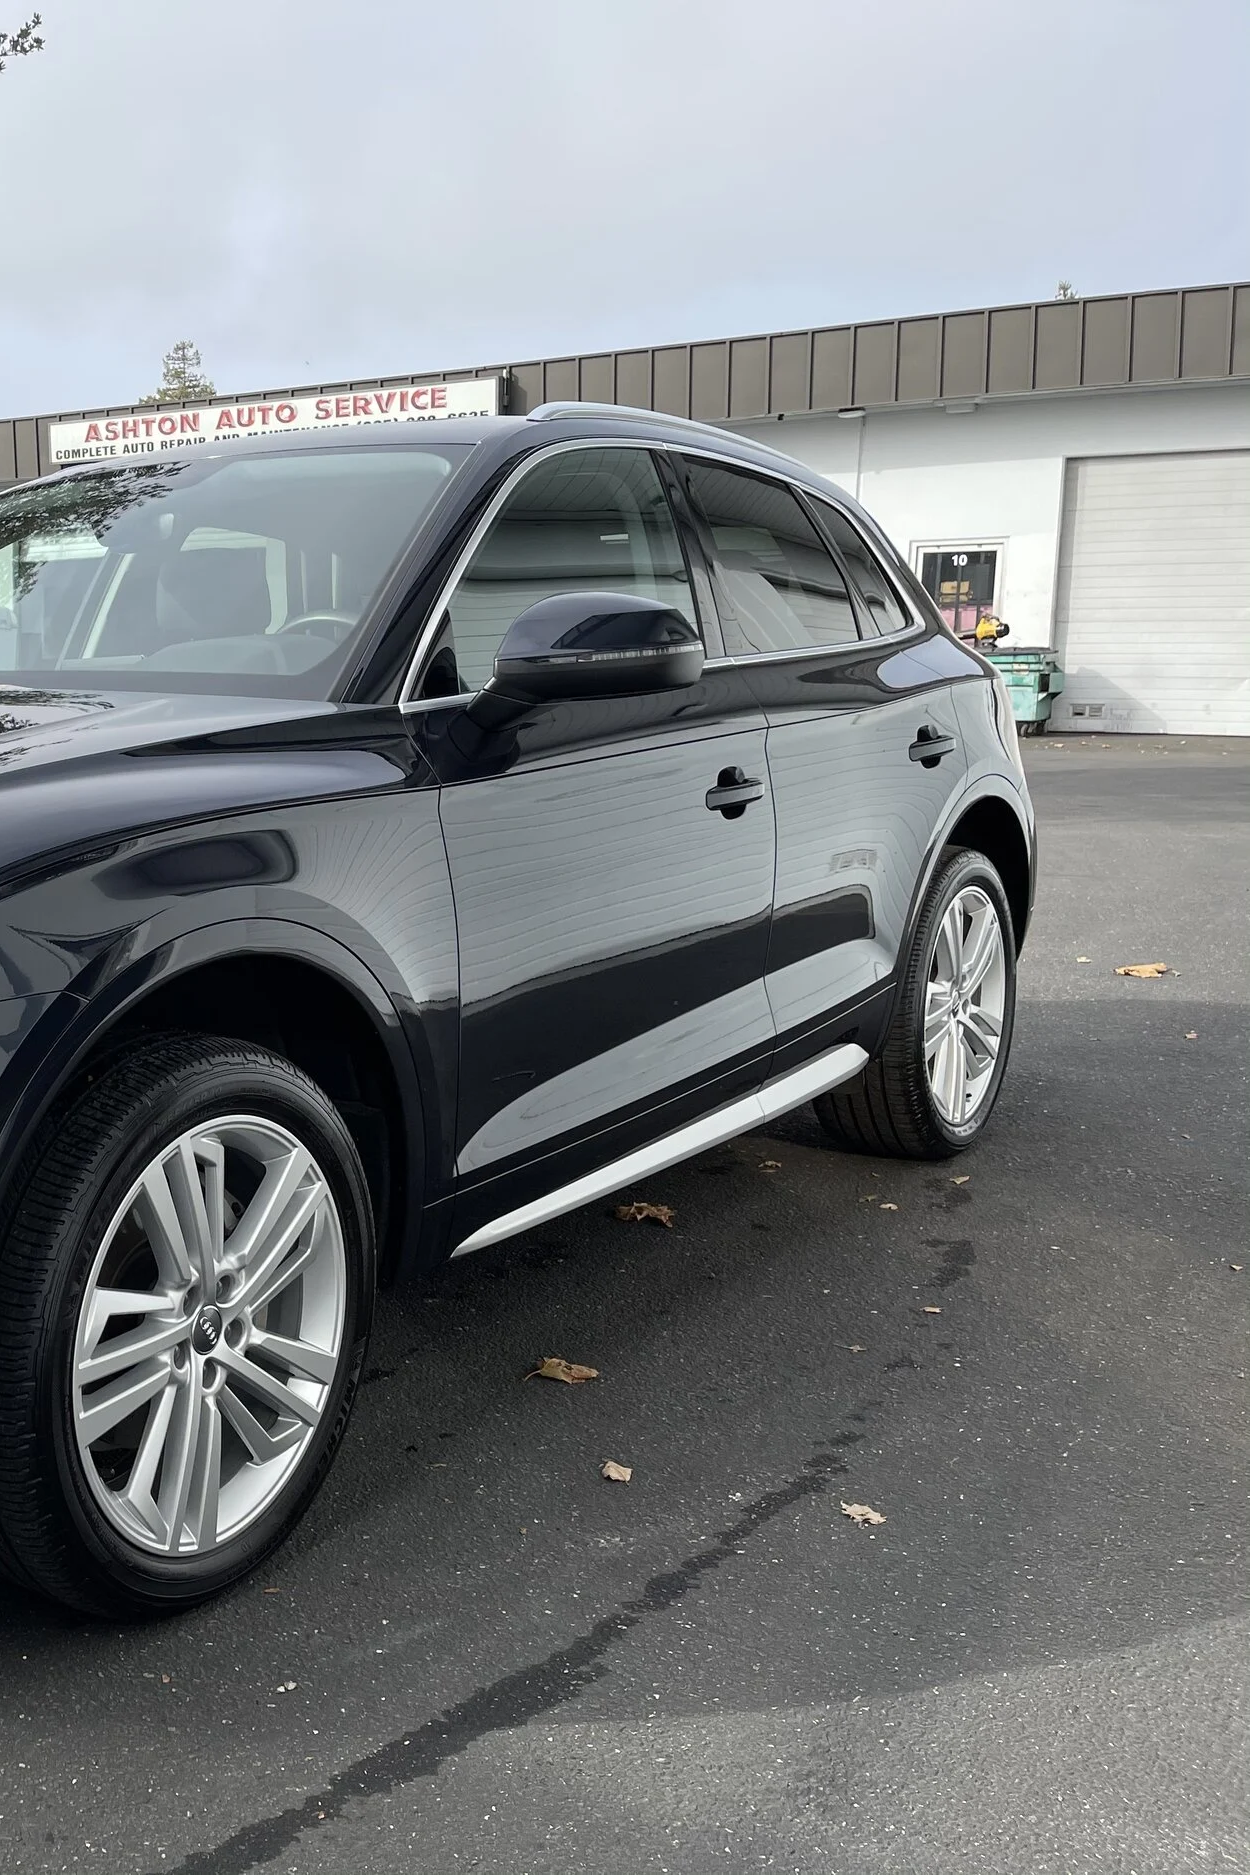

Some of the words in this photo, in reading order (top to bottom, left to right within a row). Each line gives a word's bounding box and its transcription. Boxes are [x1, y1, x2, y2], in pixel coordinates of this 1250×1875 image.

[84, 412, 200, 443] ASHTON
[216, 402, 299, 430] AUTO
[315, 386, 448, 420] SERVICE
[56, 445, 117, 460] COMPLETE
[123, 441, 154, 454] AUTO
[951, 554, 968, 567] 10
